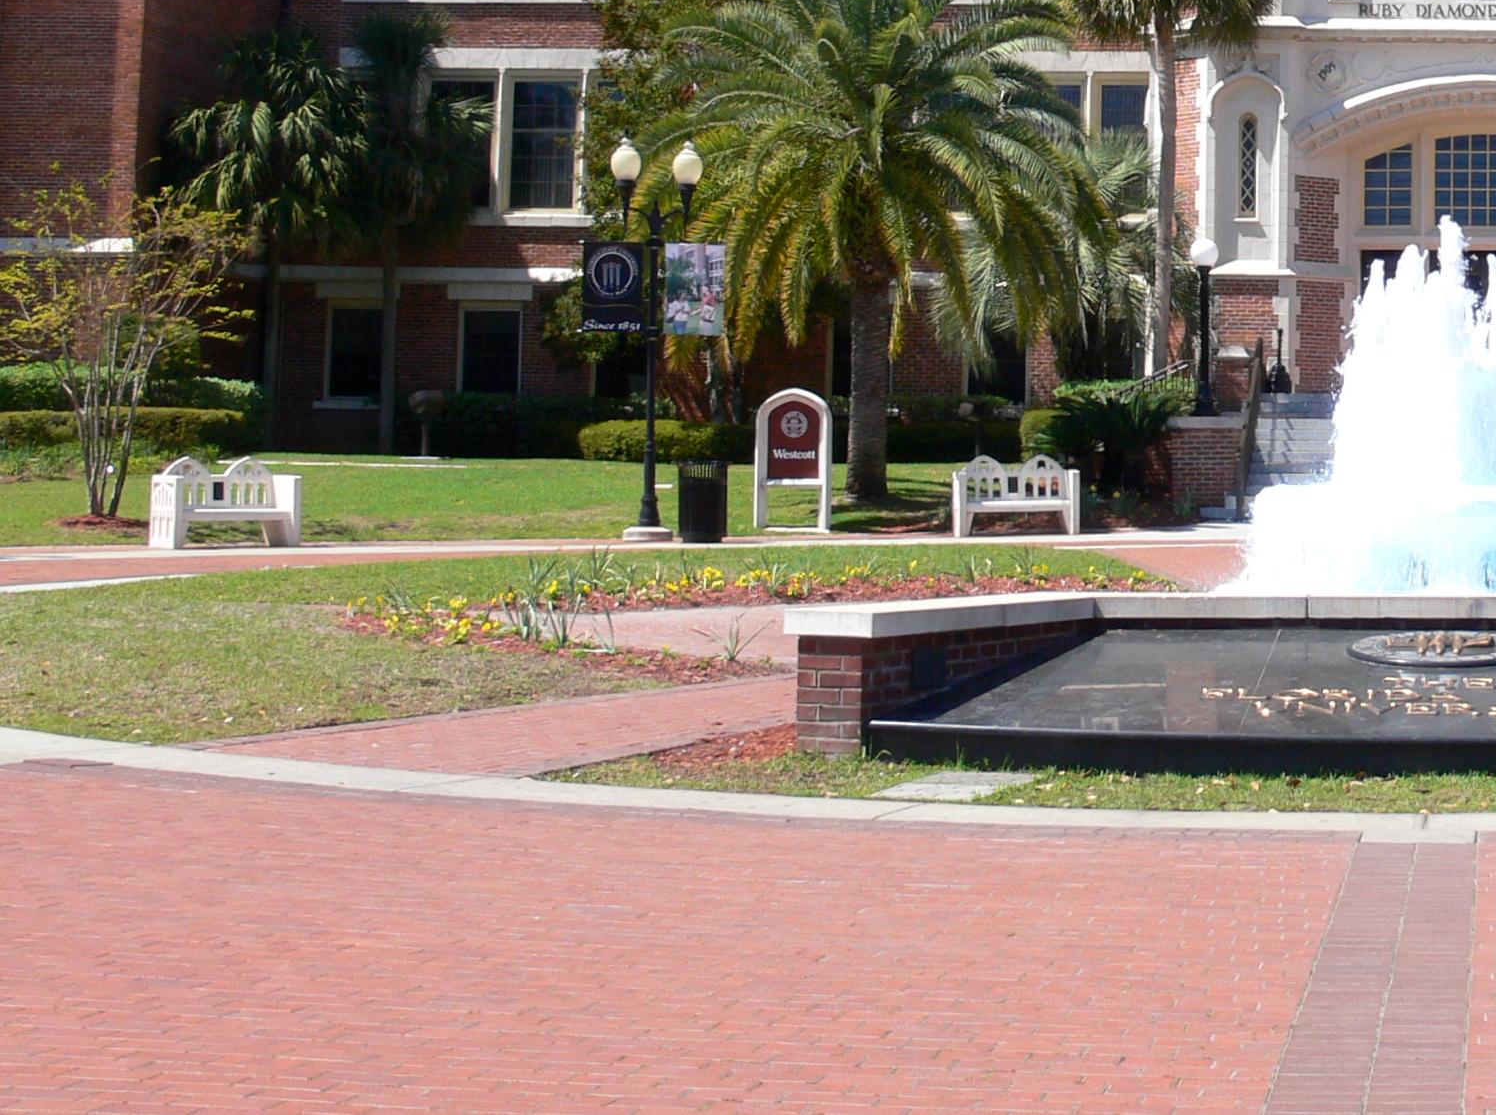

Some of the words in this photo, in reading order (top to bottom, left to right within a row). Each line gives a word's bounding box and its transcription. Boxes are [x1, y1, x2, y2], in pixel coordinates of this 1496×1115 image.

[1359, 3, 1405, 18] RUBY
[583, 319, 614, 330] Since
[618, 321, 640, 332] 1851
[772, 448, 816, 460] Westcott
[1384, 676, 1496, 689] THE
[1202, 688, 1464, 702] FLORIDA
